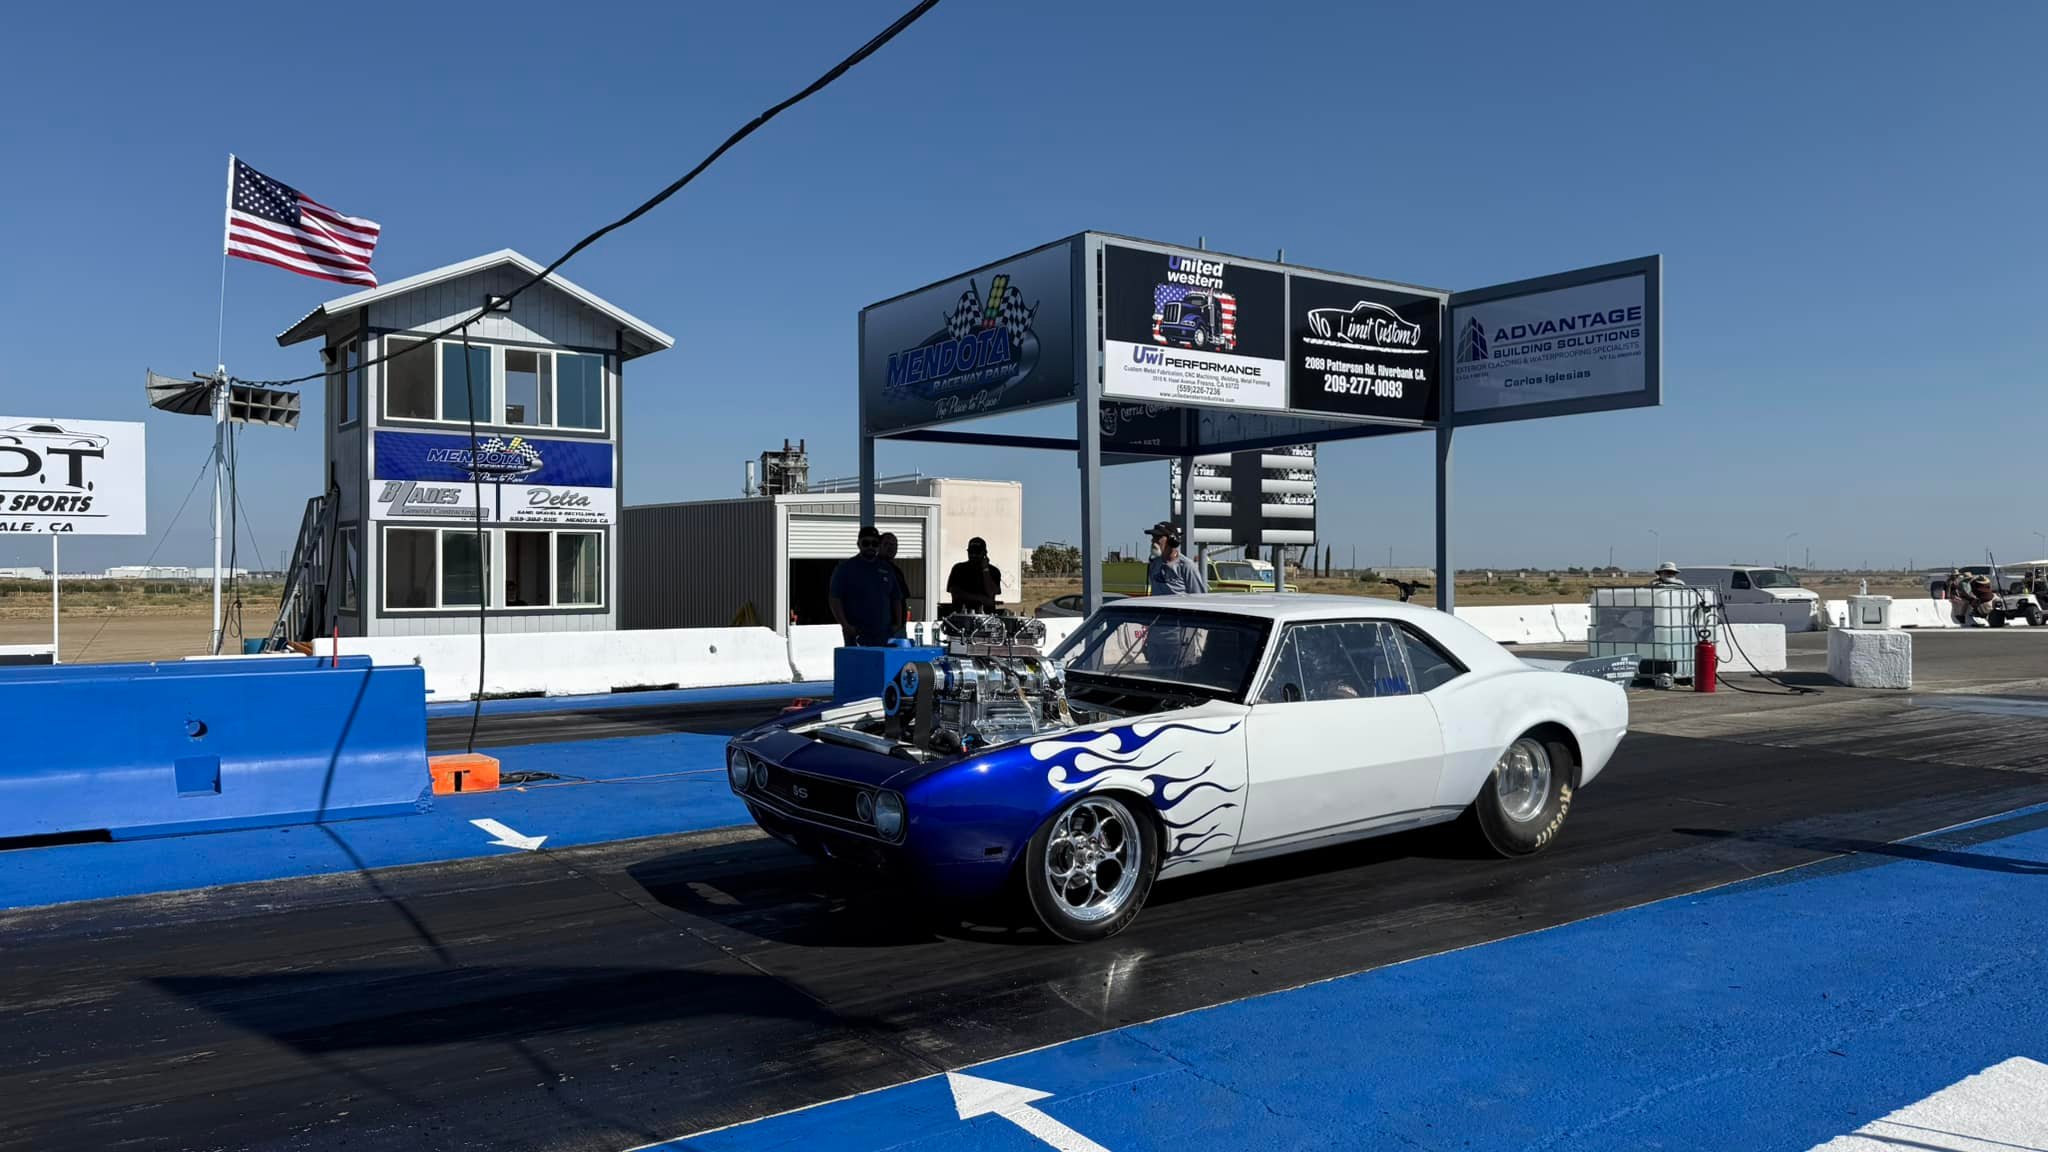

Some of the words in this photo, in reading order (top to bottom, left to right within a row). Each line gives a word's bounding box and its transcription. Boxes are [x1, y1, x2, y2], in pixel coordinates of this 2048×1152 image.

[1168, 255, 1224, 277] United
[1167, 271, 1223, 289] western
[1337, 315, 1374, 343] Limit
[1375, 319, 1420, 346] Customs
[1494, 305, 1642, 342] ADVANTAGE
[1494, 341, 1552, 359] BUILDING
[1556, 328, 1640, 349] SOLUTIONS
[1530, 348, 1592, 362] WATERPROOFING
[1592, 341, 1640, 353] SPECIALISTS
[886, 327, 1011, 389] MENDOTA
[1165, 357, 1261, 377] PERFORMANCE
[1305, 356, 1325, 370] 2089
[1326, 359, 1363, 374] Patterson
[1365, 363, 1376, 376] Rd.
[1378, 365, 1413, 379] Riverbank
[933, 372, 982, 391] RACEWAY
[984, 363, 1017, 379] PARK
[1324, 374, 1403, 398] 209-277-0093
[1504, 374, 1542, 388] Carlos
[1545, 369, 1591, 384] Iglesias
[426, 448, 525, 465] MENDOTA
[9, 495, 93, 512] SPORTS
[377, 481, 461, 507] BLADES
[527, 488, 591, 507] Delta
[49, 522, 74, 532] CA
